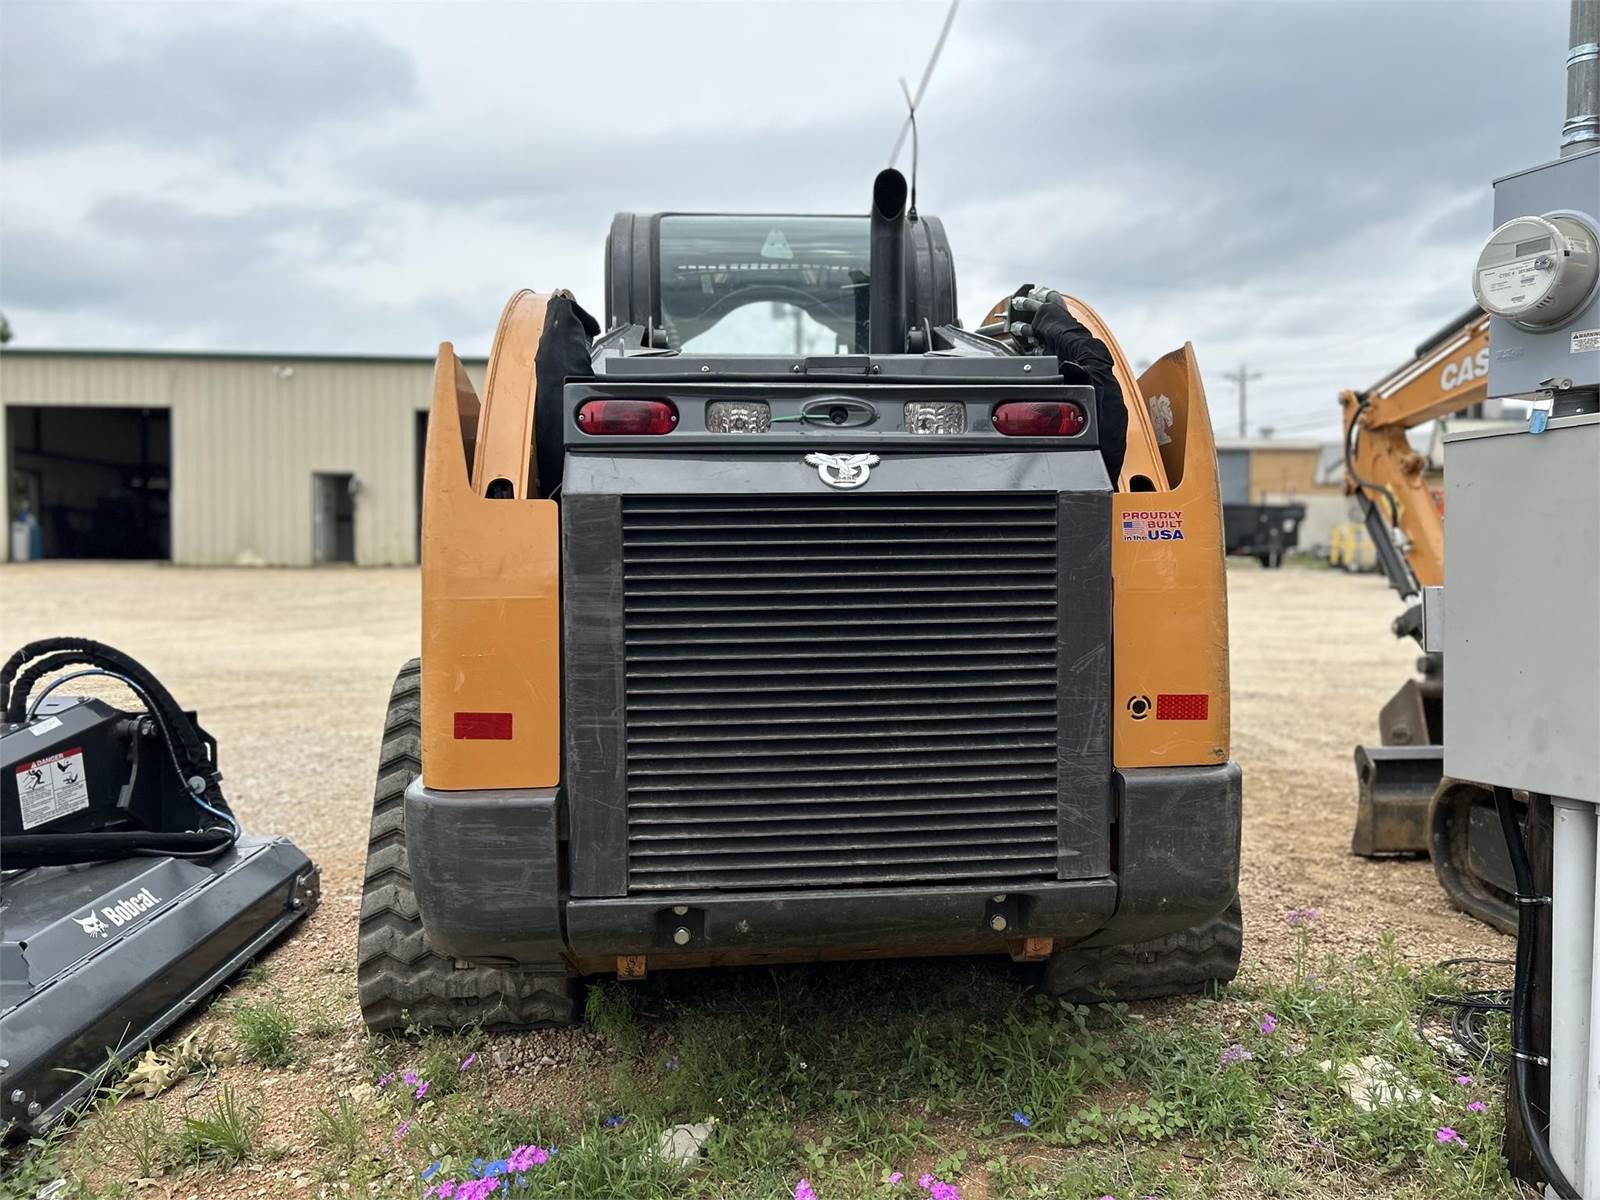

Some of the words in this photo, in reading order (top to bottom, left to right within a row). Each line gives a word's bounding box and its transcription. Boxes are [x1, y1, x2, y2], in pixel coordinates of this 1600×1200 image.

[1122, 511, 1182, 520] PROUDLY
[1147, 520, 1183, 529] BUILT
[1148, 529, 1184, 540] USA
[36, 753, 64, 767] DANGER
[101, 887, 160, 927] Bobcat
